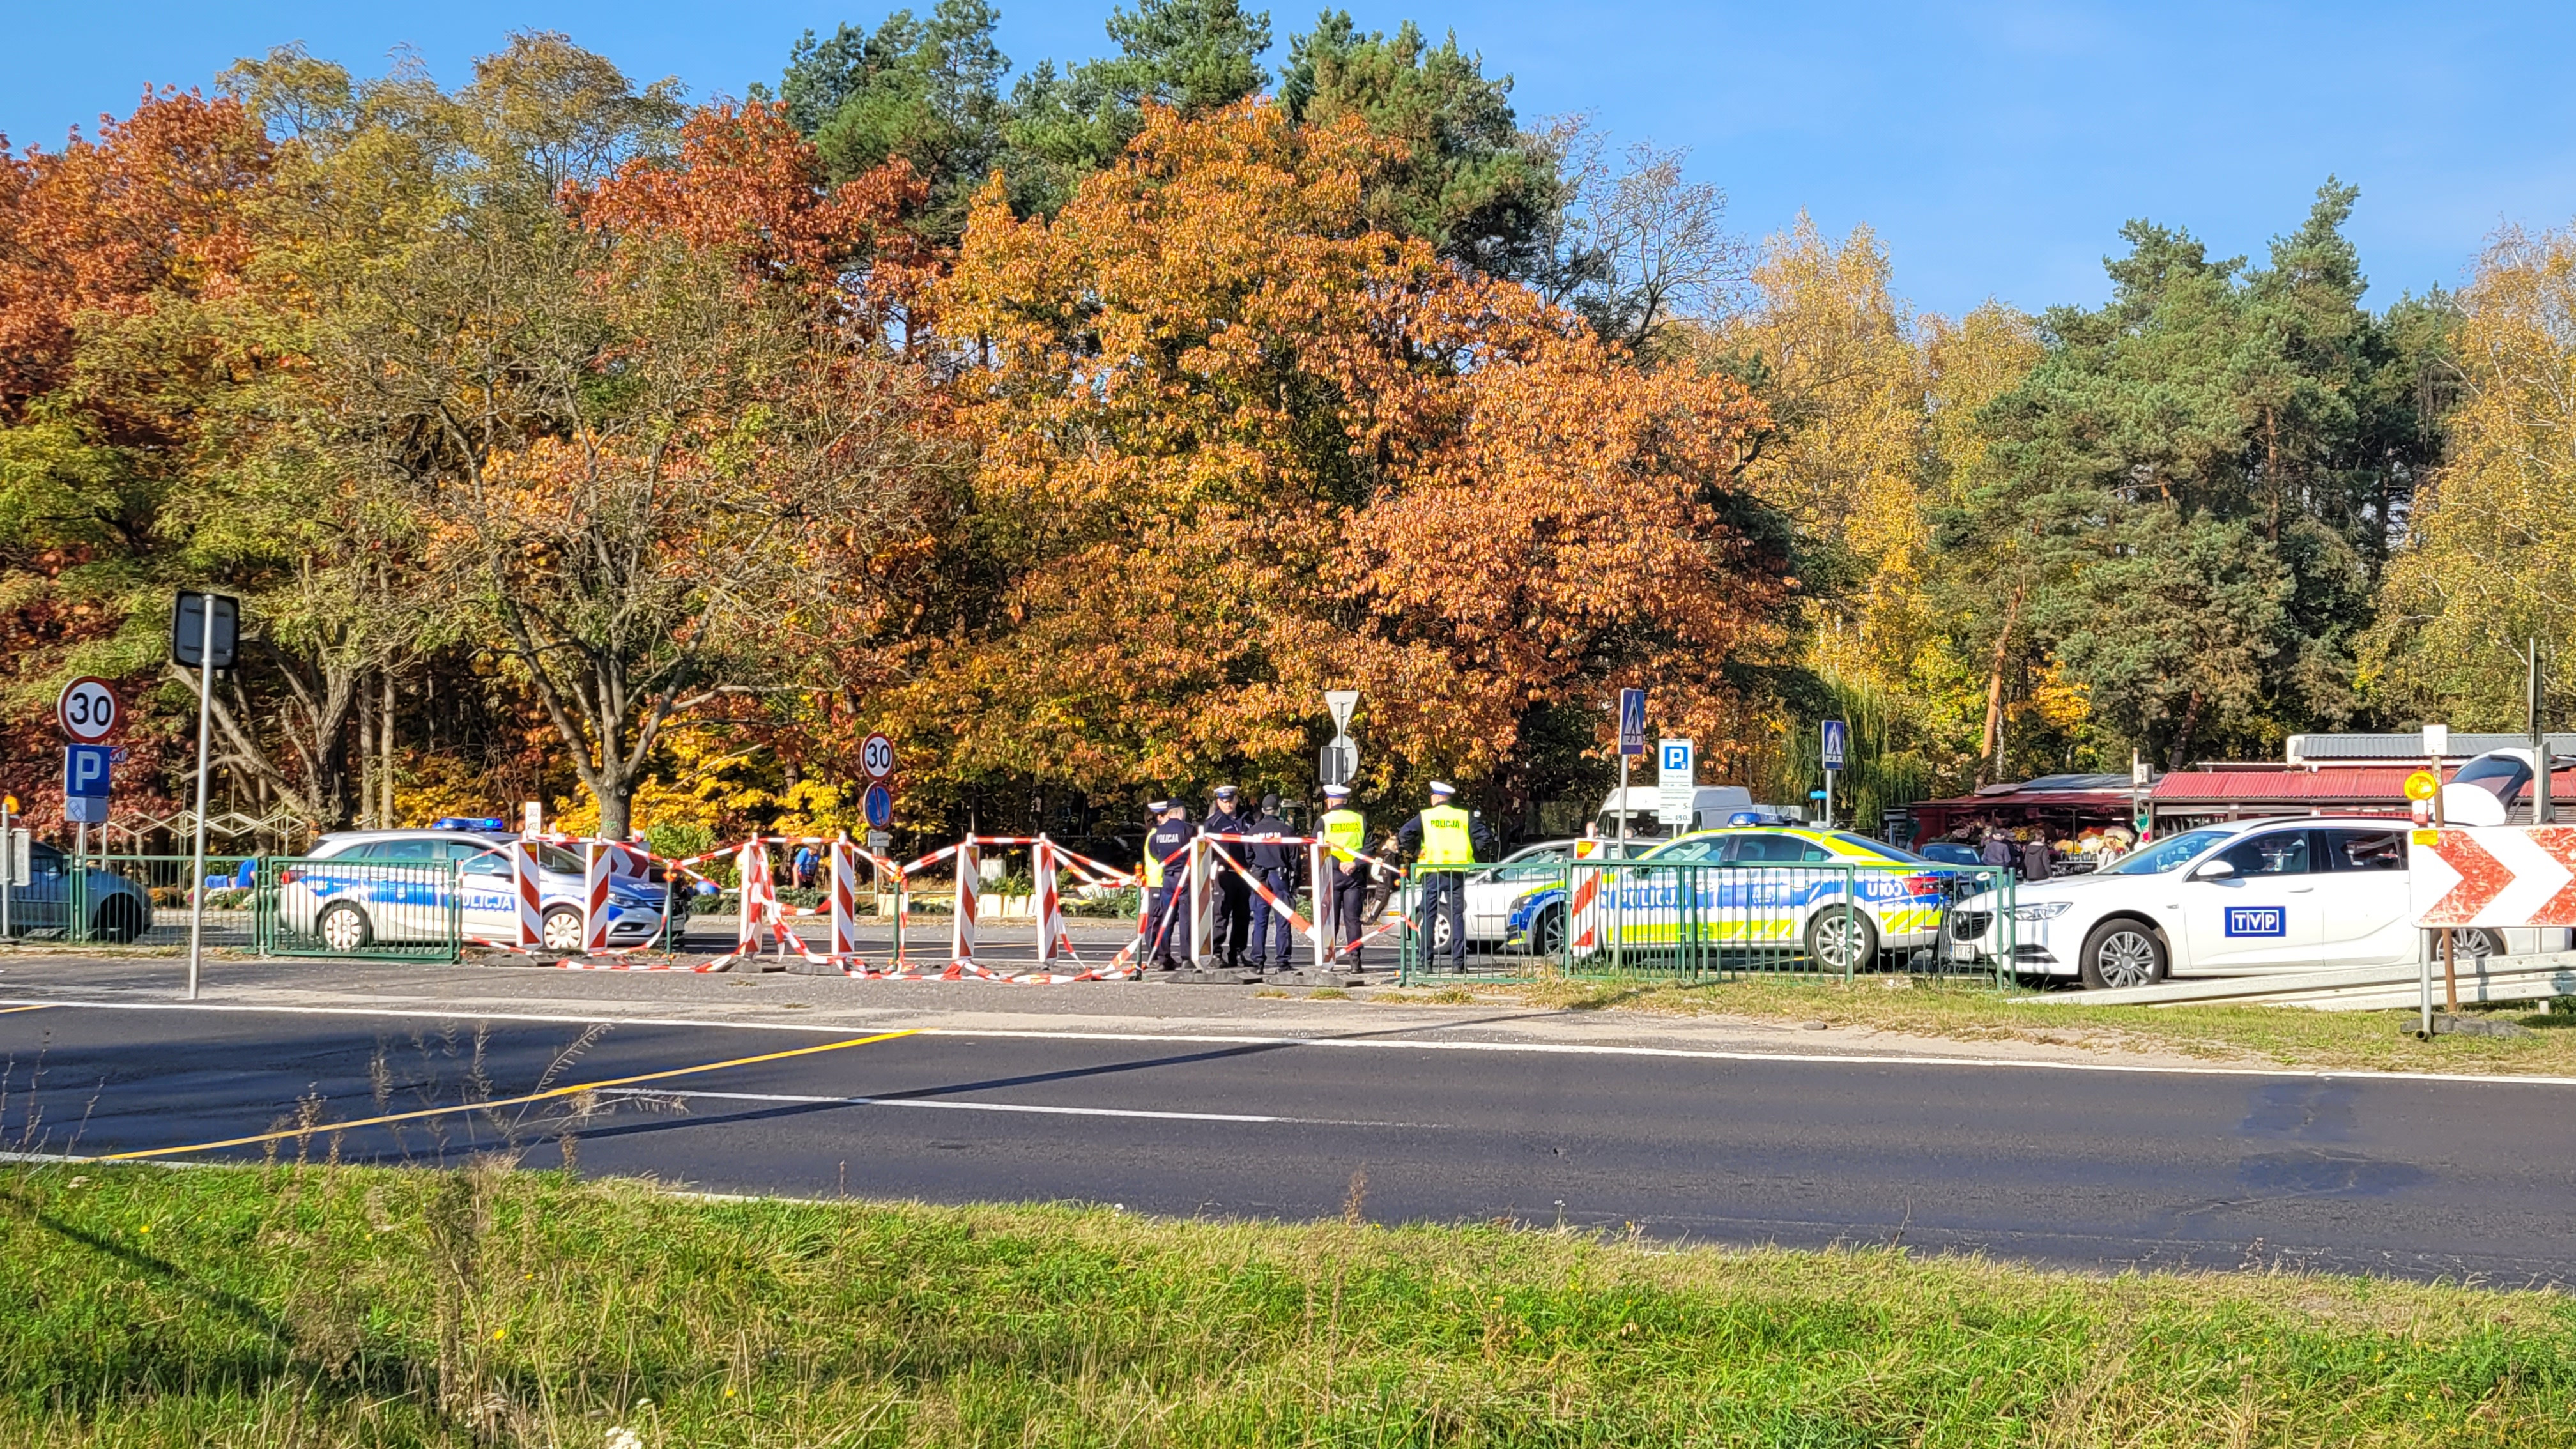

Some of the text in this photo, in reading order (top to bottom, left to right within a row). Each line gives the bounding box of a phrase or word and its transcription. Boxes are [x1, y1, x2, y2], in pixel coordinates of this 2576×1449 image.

[70, 693, 111, 726] 30
[867, 743, 891, 768] 30
[1669, 748, 1683, 767] P
[75, 751, 101, 790] P
[1431, 820, 1460, 828] POLICJA
[1156, 833, 1179, 843] POLICJA
[454, 894, 512, 908] OLICJA
[2235, 914, 2275, 929] TVP
